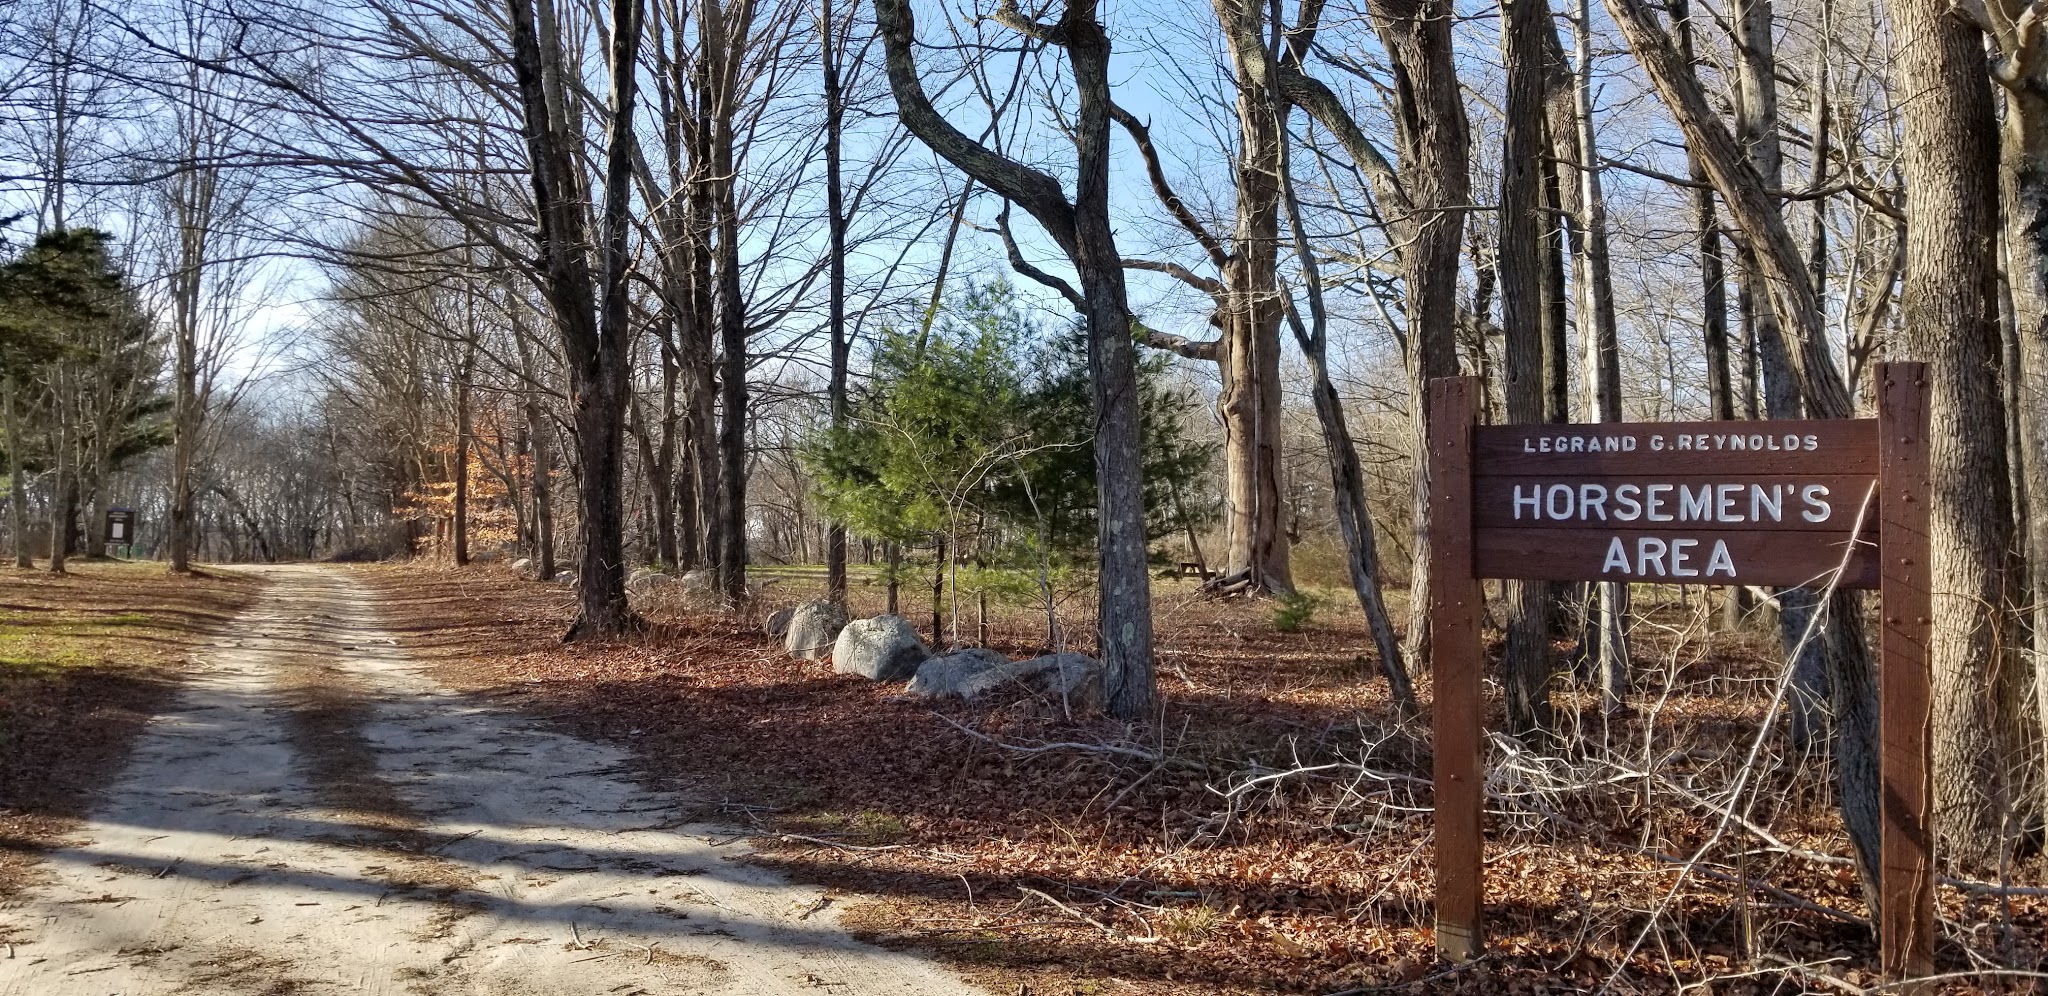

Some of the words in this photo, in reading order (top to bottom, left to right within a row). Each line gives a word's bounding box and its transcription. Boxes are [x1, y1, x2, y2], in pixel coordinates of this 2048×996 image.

[1524, 435, 1637, 453] LEGRAND
[1513, 483, 1831, 523] HORSEMEN'S
[1602, 536, 1737, 578] AREA
